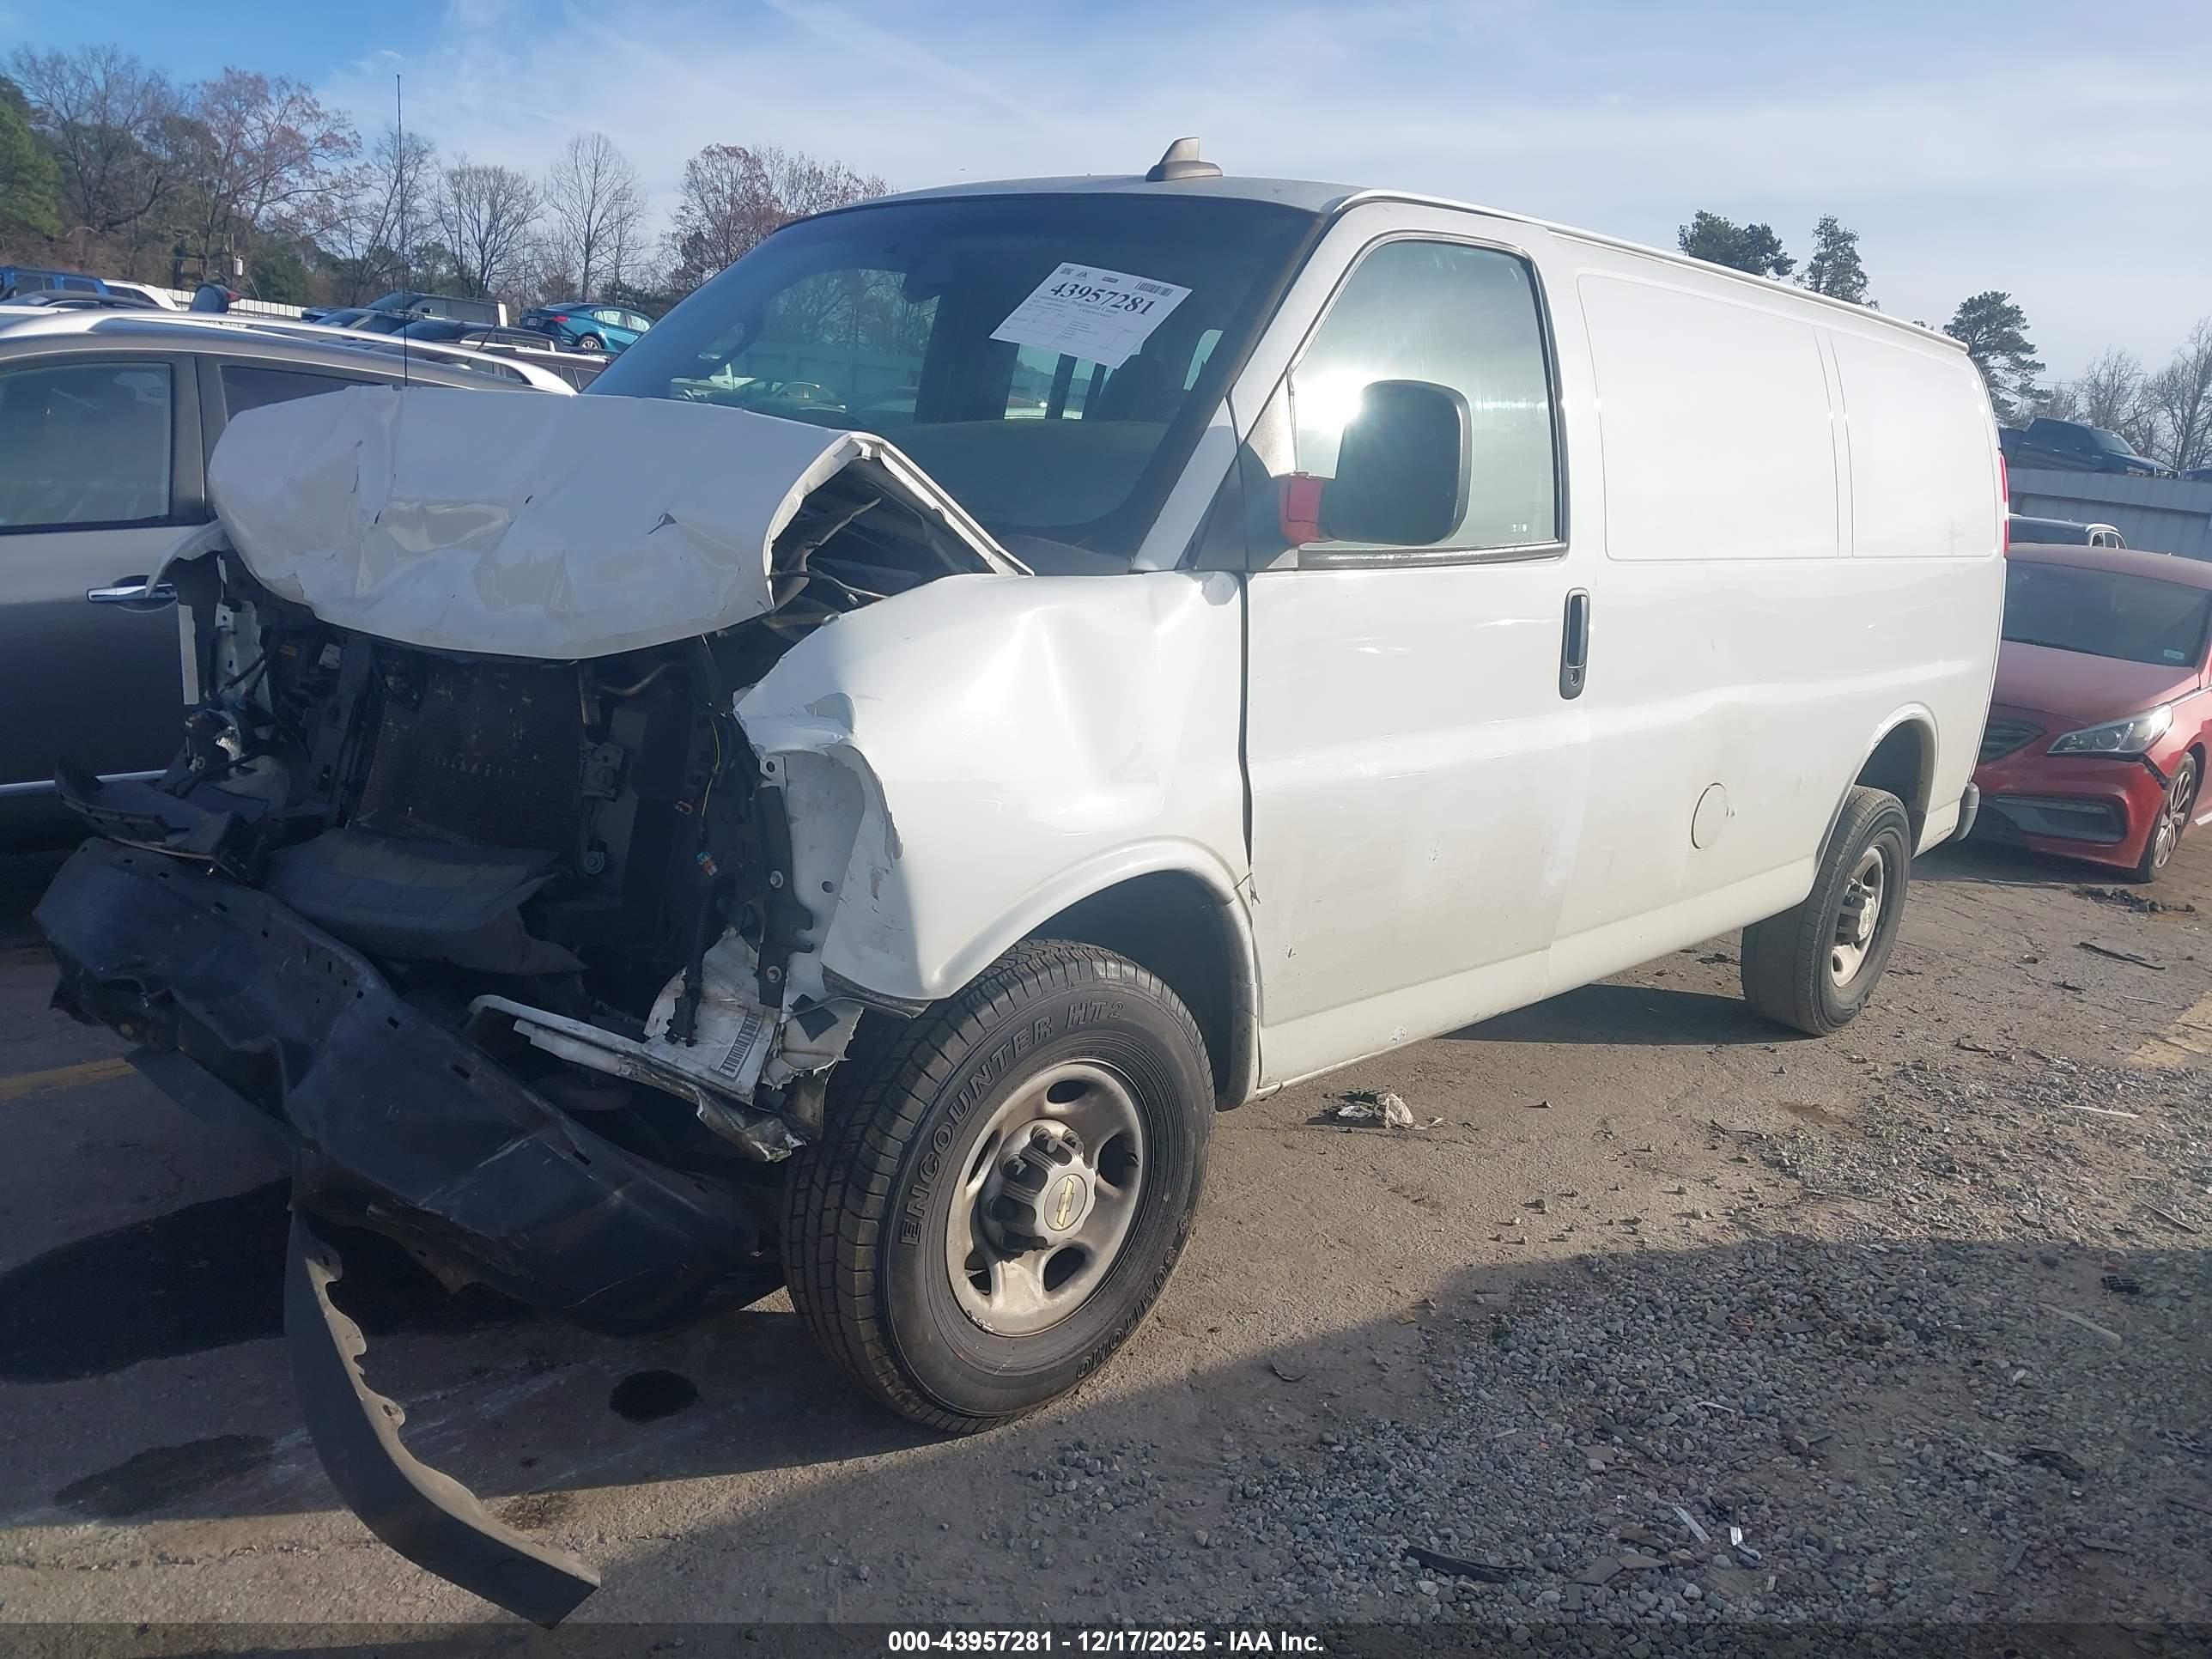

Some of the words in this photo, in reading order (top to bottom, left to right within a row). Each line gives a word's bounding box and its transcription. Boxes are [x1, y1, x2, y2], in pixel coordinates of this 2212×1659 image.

[1050, 282, 1156, 315] 43957281
[902, 1015, 1053, 1245] ENCOUNTER
[1066, 1001, 1124, 1030] HT2
